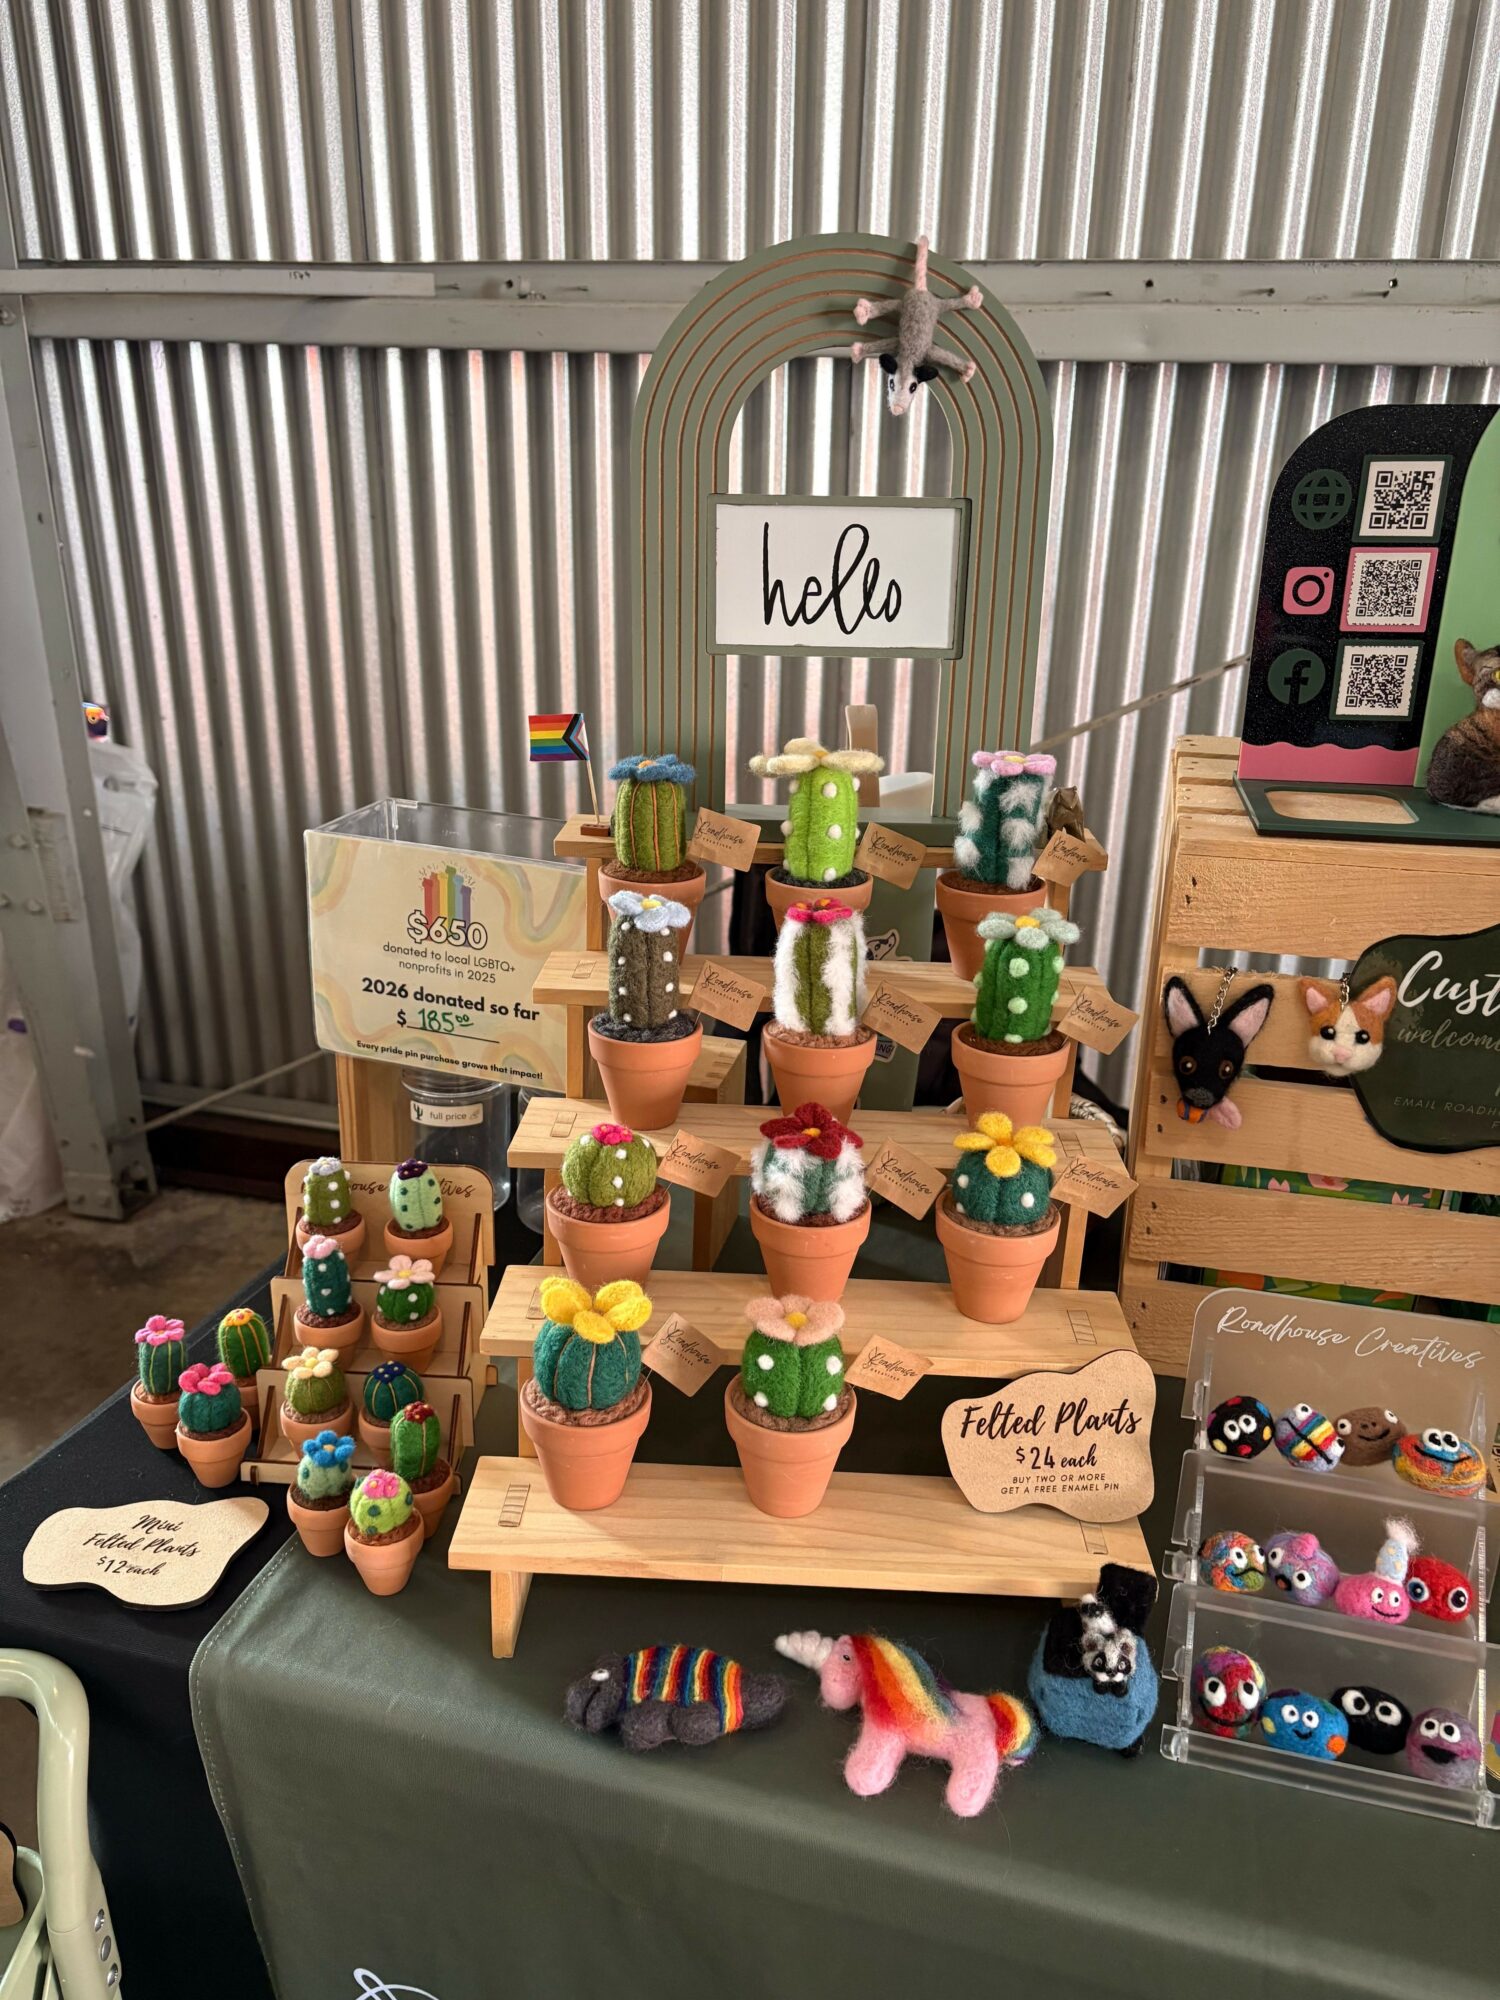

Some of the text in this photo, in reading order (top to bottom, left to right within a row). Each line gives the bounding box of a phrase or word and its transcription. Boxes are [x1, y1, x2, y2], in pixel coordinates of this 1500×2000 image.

[763, 521, 902, 635] hello
[407, 910, 488, 950] $650
[383, 941, 516, 972] donated to local LGBTQ+
[399, 961, 496, 983] nonprofits in 2025
[362, 977, 540, 1021] 2026 donated so far
[357, 1040, 543, 1080] Every pride pin purchase grows that impact!
[430, 1111, 467, 1122] full price
[1394, 1096, 1500, 1117] EMAIL ROADH
[1217, 1306, 1486, 1369] Roadhouse Creatives
[960, 1398, 1142, 1439] Felted Plants
[1061, 1443, 1097, 1468] each
[1001, 1486, 1019, 1494] GET
[1034, 1485, 1057, 1493] FREE
[1062, 1483, 1099, 1492] ENAMEL
[1013, 1476, 1031, 1484] BUY
[1060, 1474, 1074, 1482] OR
[1078, 1473, 1105, 1481] MORE
[132, 1514, 183, 1534] Mini
[83, 1533, 200, 1558] Felted Plants
